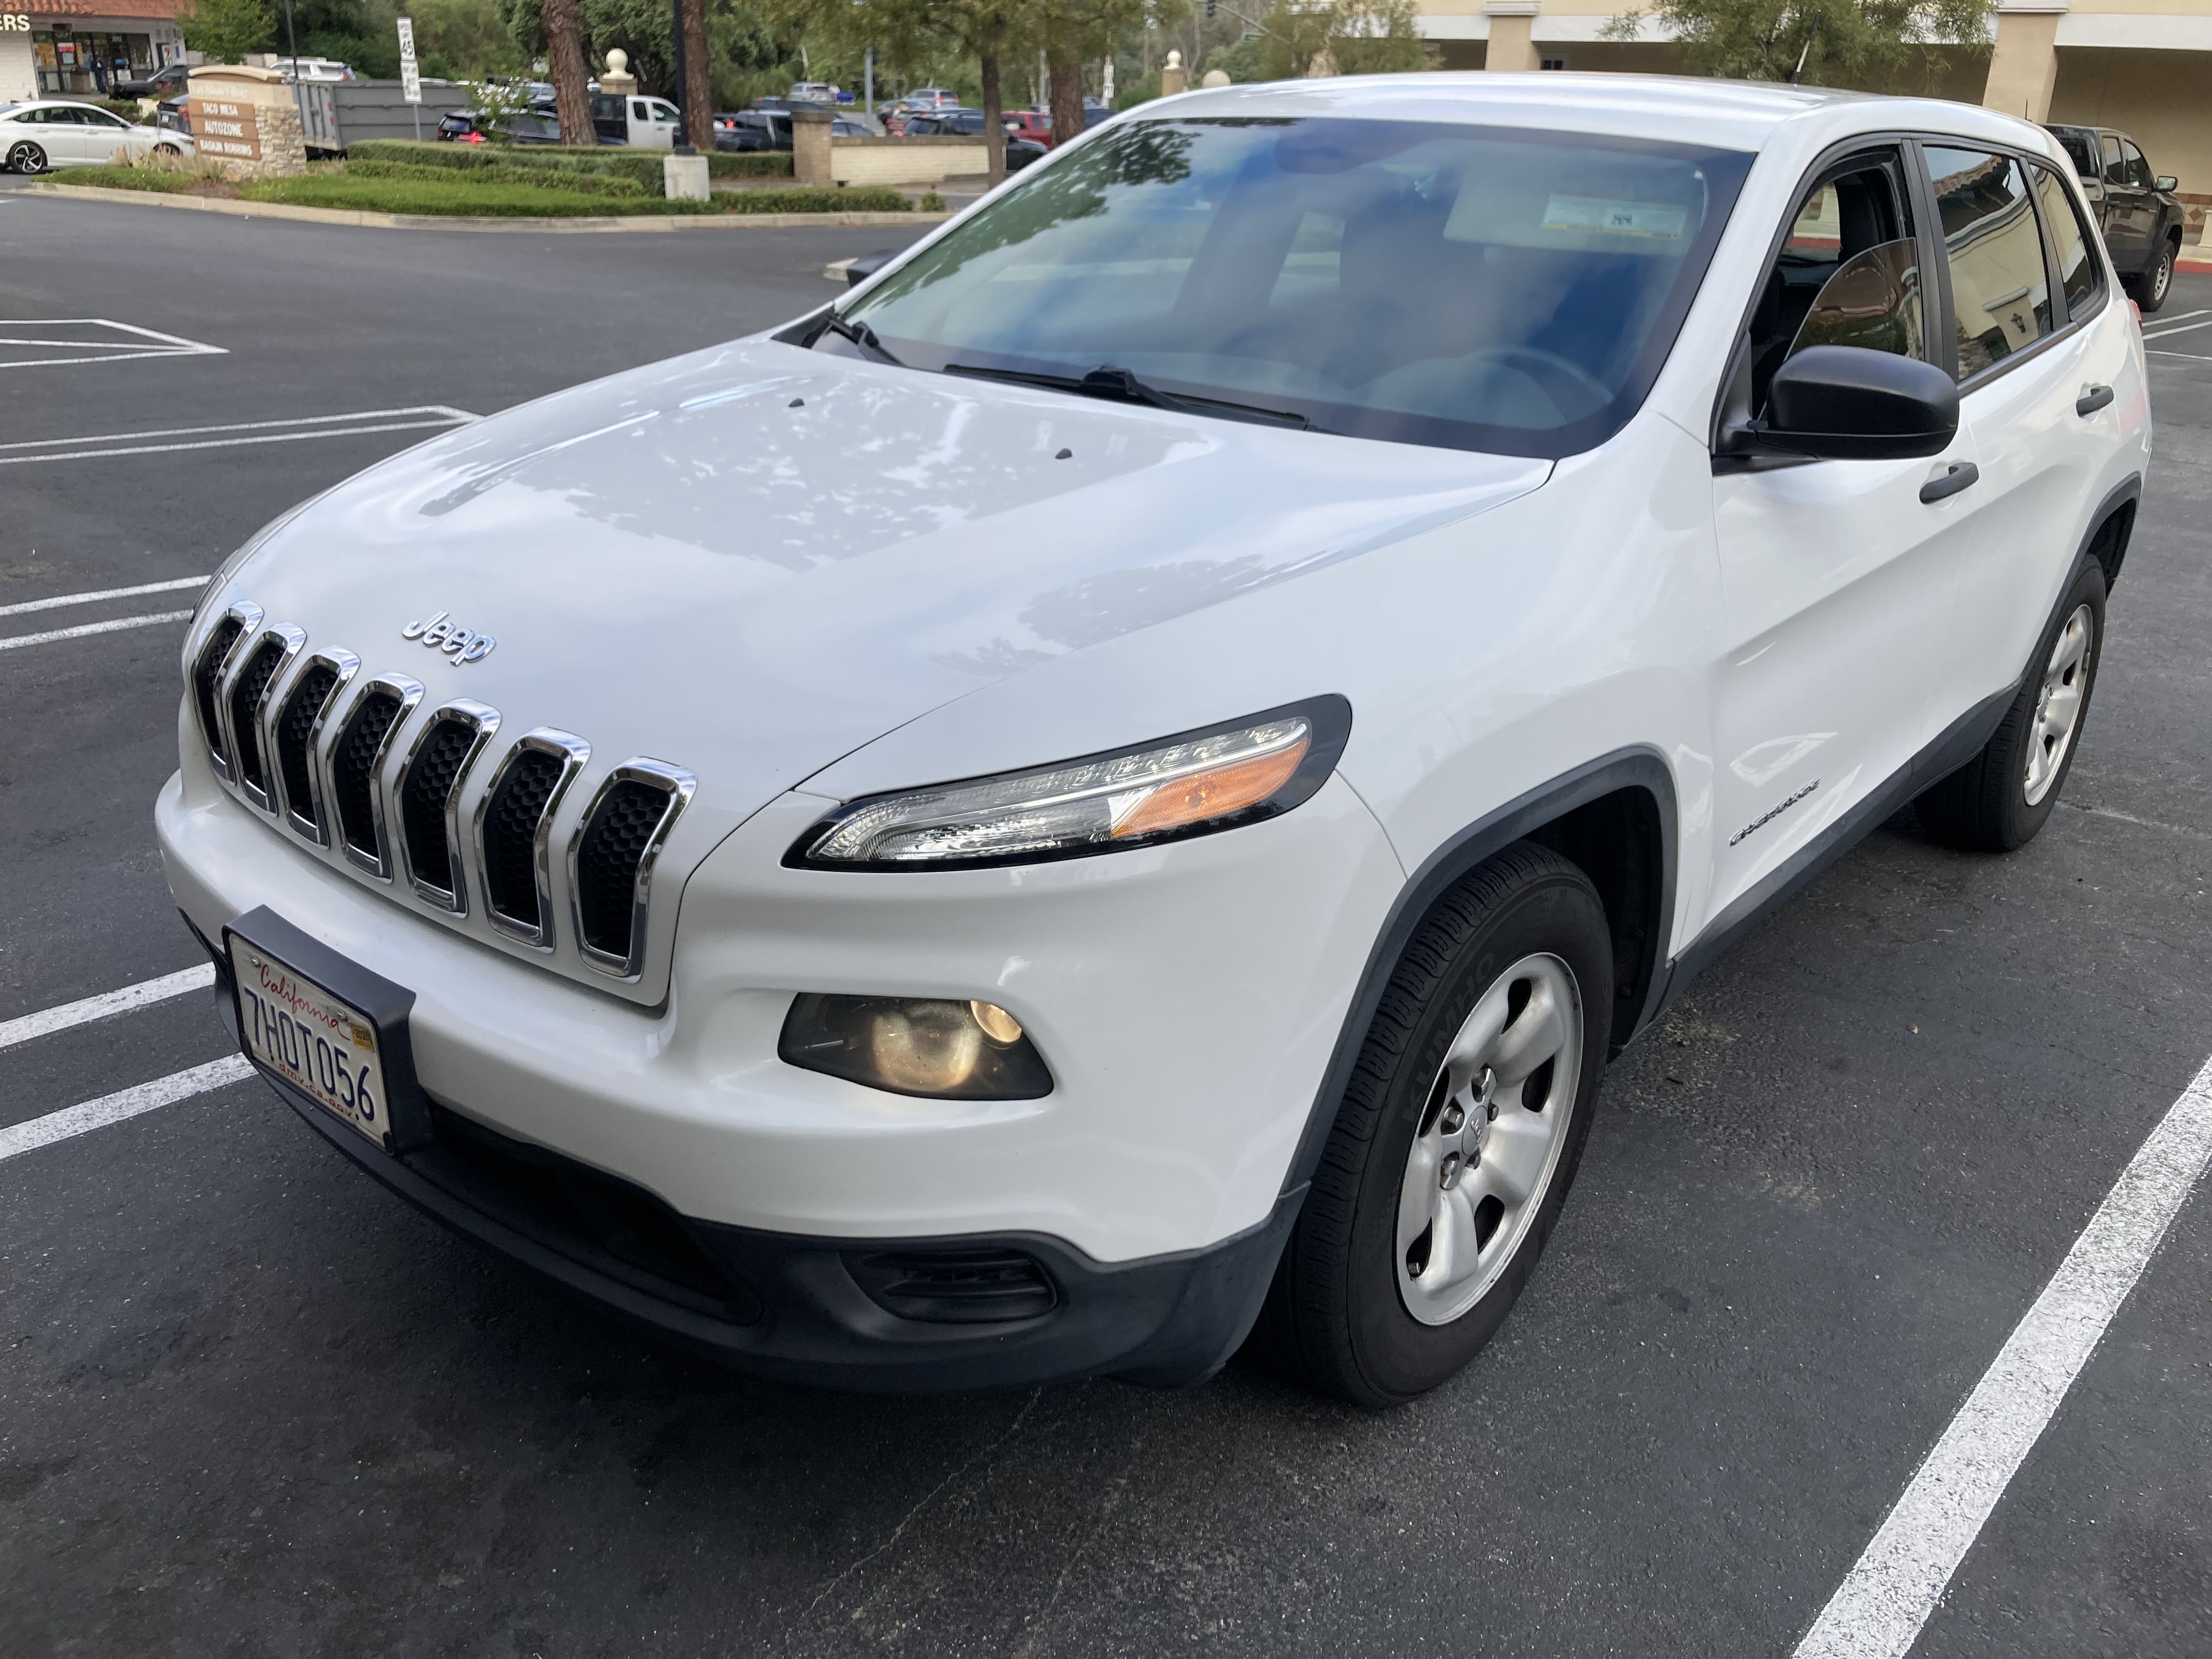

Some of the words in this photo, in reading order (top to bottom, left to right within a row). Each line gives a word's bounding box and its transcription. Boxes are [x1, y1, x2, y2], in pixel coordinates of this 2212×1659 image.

[0, 14, 31, 31] RS
[401, 40, 414, 57] 45
[201, 102, 218, 115] TACO
[219, 103, 239, 117] MESA
[205, 120, 244, 137] AUTOZONE
[200, 139, 223, 153] BASKIN
[402, 610, 497, 667] Jeep
[260, 963, 352, 1041] California
[279, 1063, 352, 1118] dmv.ca.gov
